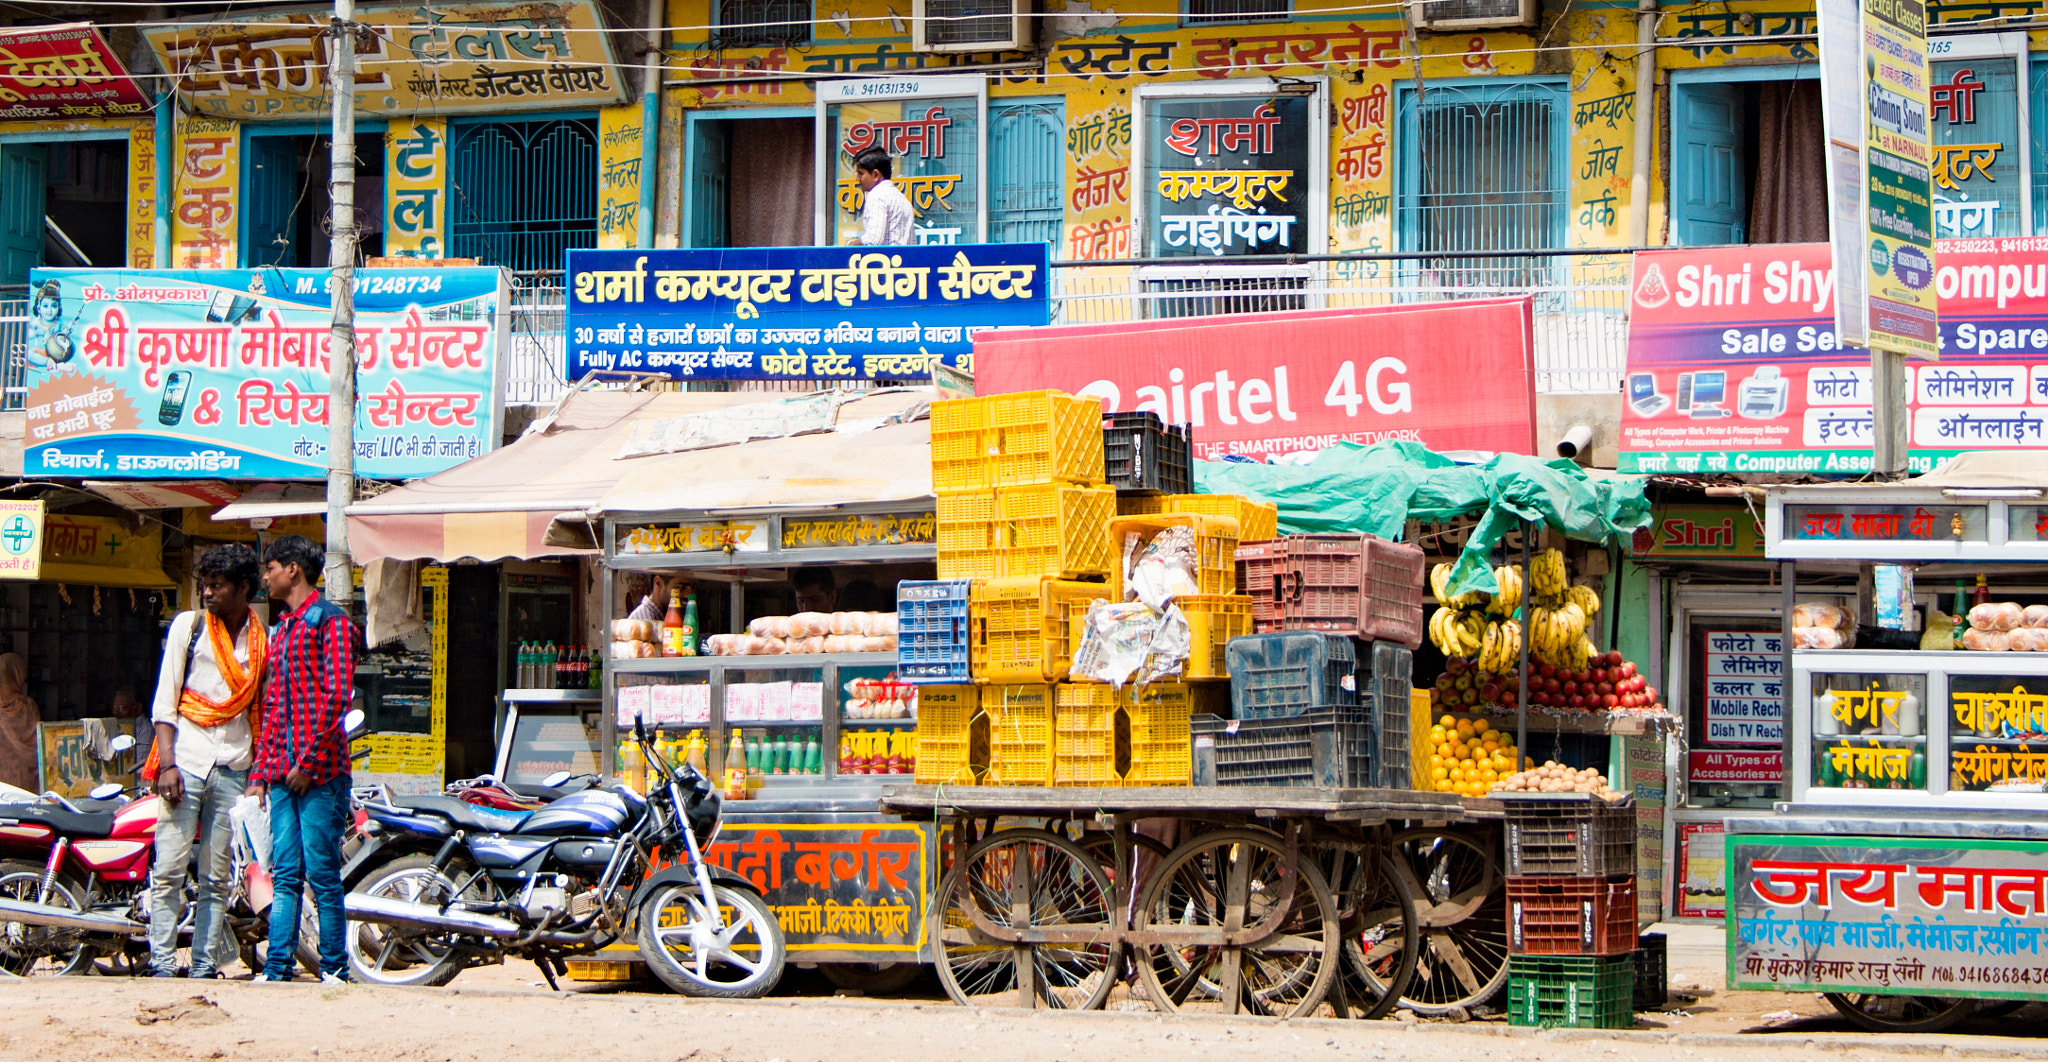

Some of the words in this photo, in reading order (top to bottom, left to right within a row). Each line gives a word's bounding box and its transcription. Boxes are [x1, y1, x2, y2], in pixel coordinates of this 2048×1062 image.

[1895, 0, 1923, 34] Classes
[1462, 37, 1492, 72] &
[1871, 86, 1901, 133] Coming
[1903, 98, 1926, 136] Soon!
[1165, 105, 1281, 155] शर्मा
[1891, 137, 1929, 163] NARNAUL
[575, 256, 648, 303] शर्मा
[654, 268, 795, 320] कम्प्यूटर
[799, 252, 931, 307] टाईपिंग
[938, 250, 1037, 301] सैन्टर
[1675, 262, 1751, 308] Shri
[83, 308, 129, 367] श्री
[138, 327, 232, 388] कृष्णा
[390, 306, 488, 370] सैन्टर
[575, 327, 593, 345] 30
[629, 322, 644, 345] से
[736, 327, 758, 345] का
[877, 320, 922, 344] बनाने
[924, 325, 962, 344] वाला
[1721, 327, 1786, 355] Sale
[579, 350, 616, 371] Fully
[620, 350, 642, 367] AC
[711, 345, 754, 369] सैन्टर
[761, 347, 809, 376] फोटो
[1136, 365, 1298, 428] airtel
[1324, 356, 1414, 418] 4G
[1813, 371, 1860, 398] फोटो
[1925, 369, 2014, 400] लेमिनेशन
[193, 388, 223, 426] &
[367, 377, 481, 428] सैन्टर
[1634, 427, 1651, 438] Types
[1651, 427, 1659, 436] of
[1659, 427, 1687, 438] Computer
[1706, 426, 1727, 436] Printer
[1732, 426, 1764, 437] Photocopy
[1765, 425, 1789, 435] Machine
[1655, 438, 1684, 448] Computer
[1684, 438, 1719, 447] Accessories
[1720, 437, 1732, 446] and
[1733, 437, 1753, 446] Printer
[1754, 436, 1782, 446] Solutions
[1938, 410, 2044, 445] ऑनलाईन
[381, 436, 404, 458] LIC
[1195, 442, 1226, 457] THE
[1228, 434, 1338, 456] SMARTPHONE
[1638, 452, 1669, 473] हमारे
[1735, 452, 1822, 474] Computer
[1663, 518, 1734, 548] Shri
[1800, 512, 1844, 537] जय
[1850, 512, 1904, 537] माता
[1908, 506, 1936, 538] दी
[1712, 633, 1755, 653] फोटो
[1712, 682, 1754, 696] कलर
[1711, 699, 1749, 717] Mobile
[1752, 700, 1782, 717] Rech
[1711, 723, 1735, 738] Dish
[1738, 724, 1753, 738] TV
[1756, 724, 1782, 739] Rech
[1692, 768, 1765, 779] Accessories
[1706, 754, 1722, 765] All
[1725, 754, 1760, 767] Types
[1764, 754, 1777, 766] of
[795, 829, 919, 891] बर्गर
[1751, 860, 1910, 911] जय
[1528, 981, 1536, 1023] KRISH
[1569, 982, 1577, 1025] KUSH
